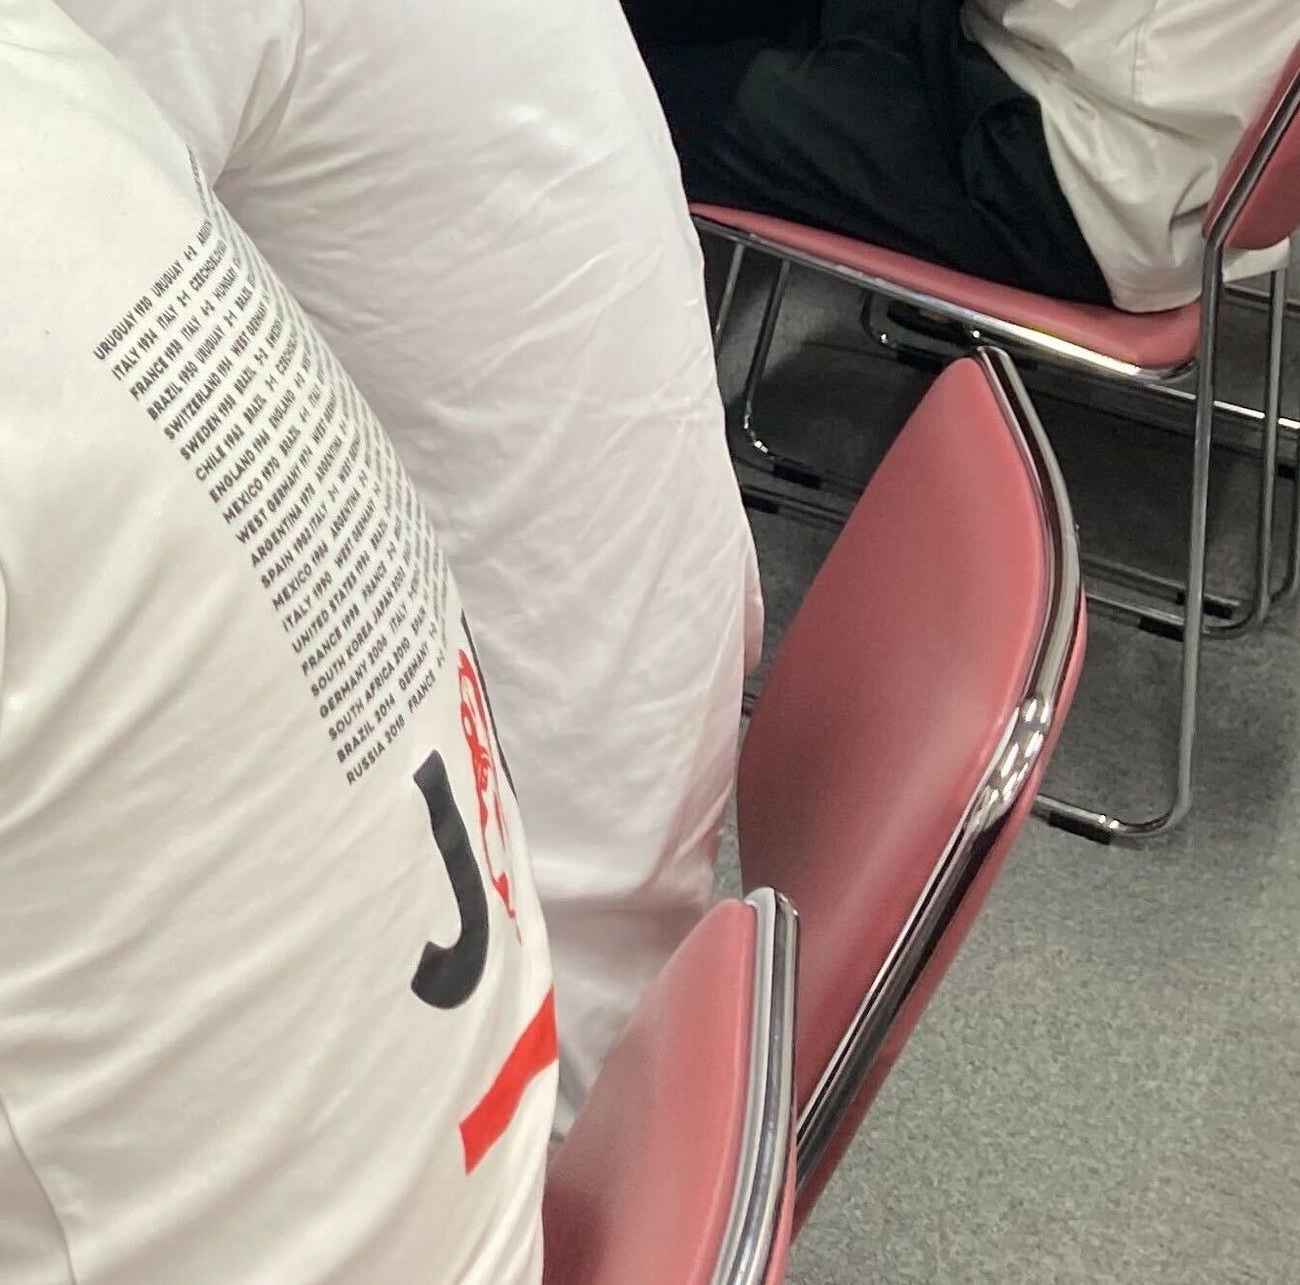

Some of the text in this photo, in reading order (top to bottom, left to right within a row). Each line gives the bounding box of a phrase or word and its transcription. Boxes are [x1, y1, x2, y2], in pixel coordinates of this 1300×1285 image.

[92, 310, 138, 360] URUGUAY
[134, 295, 154, 317] 1930
[151, 260, 184, 298] URUGUAY
[111, 346, 142, 381] ITALY
[137, 328, 159, 353] 1934
[156, 303, 179, 330] ITALY
[128, 355, 170, 401] FRANCE
[164, 338, 184, 361] 1938
[180, 316, 202, 342] ITALY
[146, 382, 183, 420] BRAZIL
[178, 360, 199, 385] 1950
[194, 324, 226, 364] URUGUAY
[234, 286, 253, 311] BRAZIL
[163, 372, 222, 440] SWITZERLAND
[216, 356, 234, 378] 1954
[230, 330, 250, 357] WEST
[180, 415, 221, 460] SWEDEN
[218, 393, 237, 418] 1958
[233, 365, 258, 395] BRAZIL
[195, 445, 227, 481] CHILE
[223, 423, 245, 450] 1962
[242, 394, 267, 425] BRAZIL
[208, 448, 256, 503] ENGLAND
[252, 428, 271, 453] 1966
[268, 389, 296, 430] ENGLAND
[223, 477, 264, 524] MEXICO
[261, 456, 281, 482] 1970
[278, 425, 302, 457] BRAZIL
[235, 508, 269, 544] WEST
[267, 464, 302, 513] GERMANY
[298, 445, 314, 468] 1974
[251, 503, 303, 568] ARGENTINA
[315, 434, 343, 484] ARGENTINA
[260, 550, 294, 589] SPAIN
[292, 527, 312, 557] 1982
[309, 501, 328, 533] ITALY
[271, 563, 312, 611] MEXICO
[310, 540, 329, 564] 1986
[329, 487, 361, 540] ARGENTINA
[282, 594, 312, 632] ITALY
[312, 570, 333, 600] 1990
[333, 537, 355, 570] WEST
[351, 498, 377, 543] GERMANY
[292, 519, 388, 654] UNITED STATES 1994 BRAZIL
[301, 626, 343, 676] FRANCE
[342, 603, 361, 632] 1998
[361, 560, 388, 603] FRANCE
[310, 655, 347, 697] SOUTH
[346, 620, 374, 661] KOREA
[372, 586, 394, 625] JAPAN
[319, 659, 369, 718] GERMANY
[368, 634, 388, 665] 2006
[388, 603, 408, 634] ITALY
[328, 698, 365, 741] SOUTH
[365, 661, 395, 704] AFRICA
[393, 636, 411, 665] 2010
[336, 720, 376, 763] BRAZIL
[374, 692, 396, 723] 2014
[398, 641, 430, 691] GERMANY
[346, 741, 386, 785] RUSSIA
[384, 714, 406, 744] 2018
[407, 669, 437, 713] FRANCE
